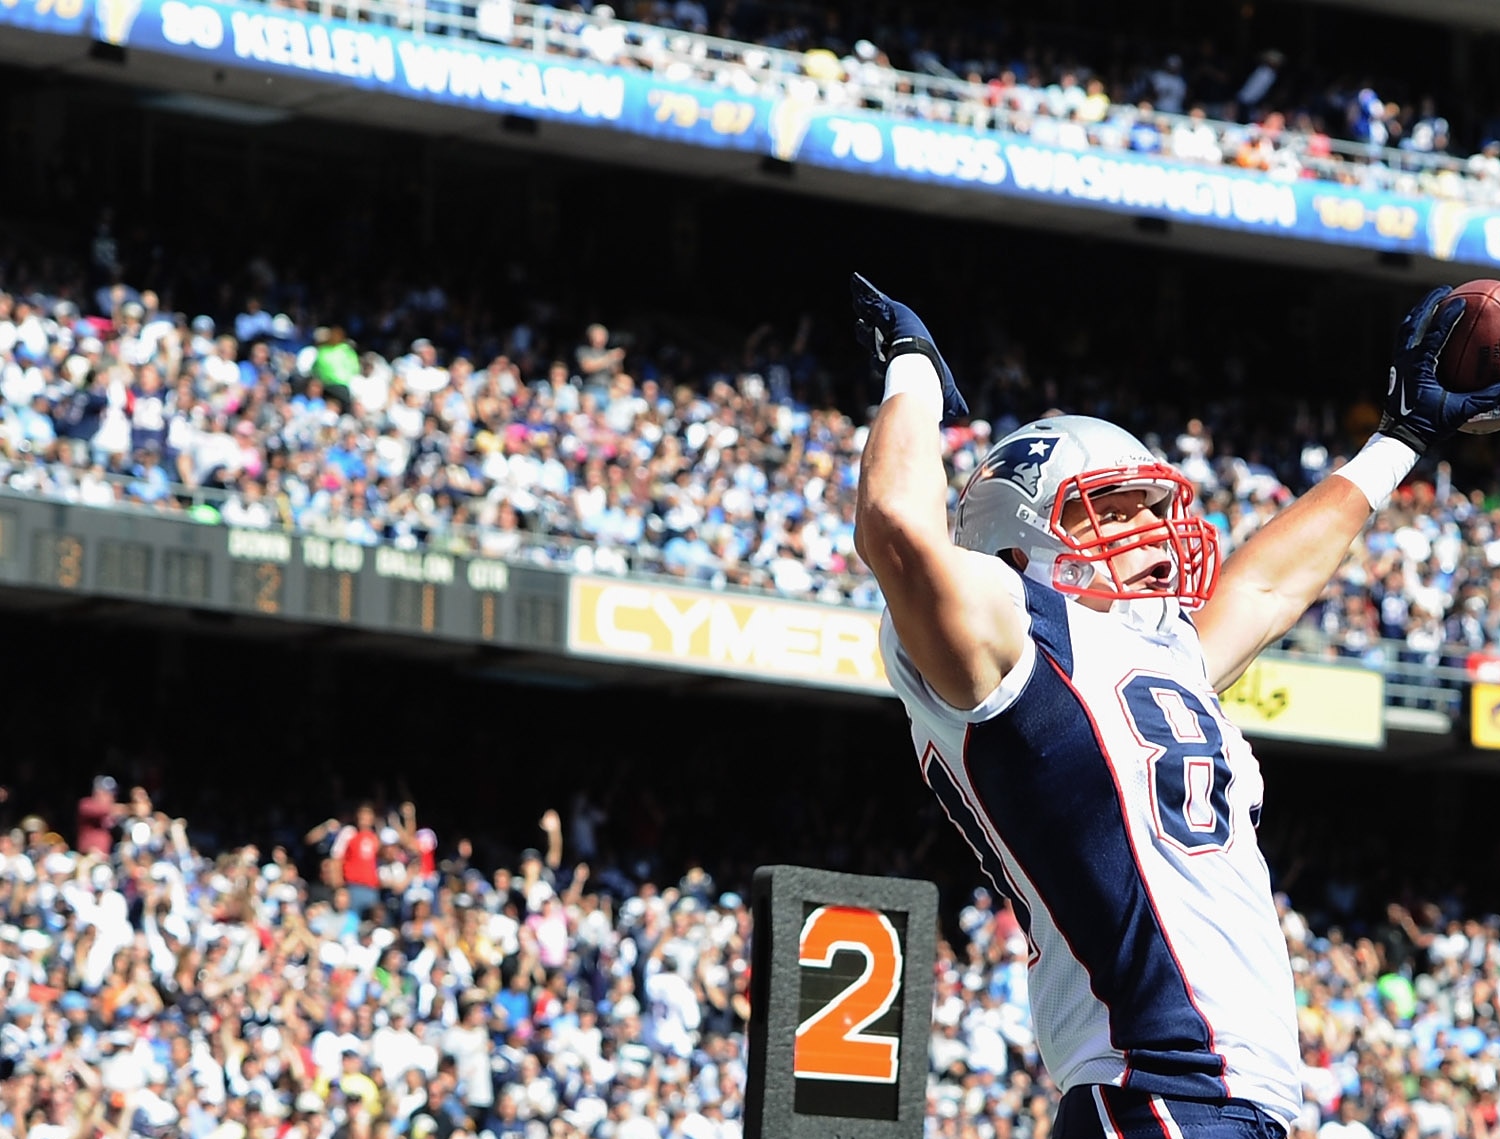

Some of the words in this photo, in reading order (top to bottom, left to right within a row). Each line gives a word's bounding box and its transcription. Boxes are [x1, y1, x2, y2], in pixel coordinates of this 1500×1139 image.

[232, 11, 395, 82] KELLEN
[399, 40, 625, 120] WINSLOW
[890, 125, 1007, 185] RUSS
[1005, 144, 1298, 228] WASHINGTON
[594, 584, 878, 680] CYMER
[794, 904, 903, 1084] 2
